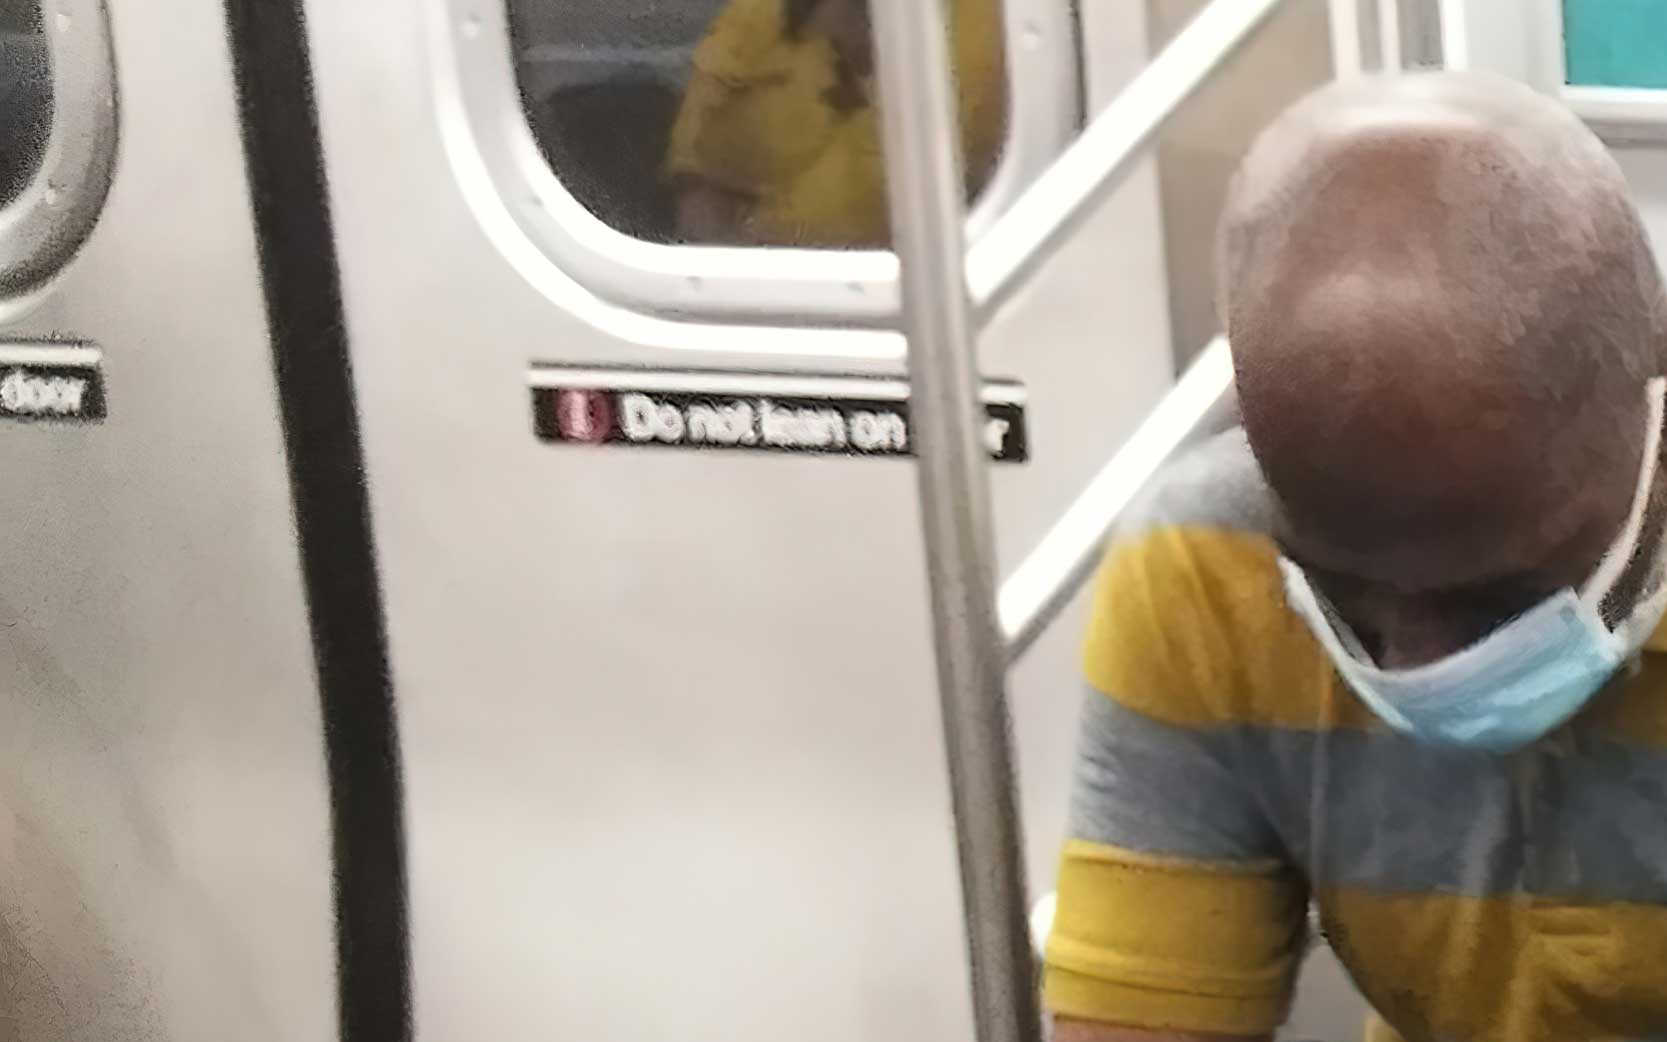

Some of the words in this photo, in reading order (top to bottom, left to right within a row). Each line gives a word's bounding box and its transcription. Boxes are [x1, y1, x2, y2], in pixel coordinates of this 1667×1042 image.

[1, 371, 86, 414] door
[622, 394, 684, 443] Do
[687, 400, 755, 446] not
[761, 400, 845, 449] lean
[850, 410, 907, 449] on
